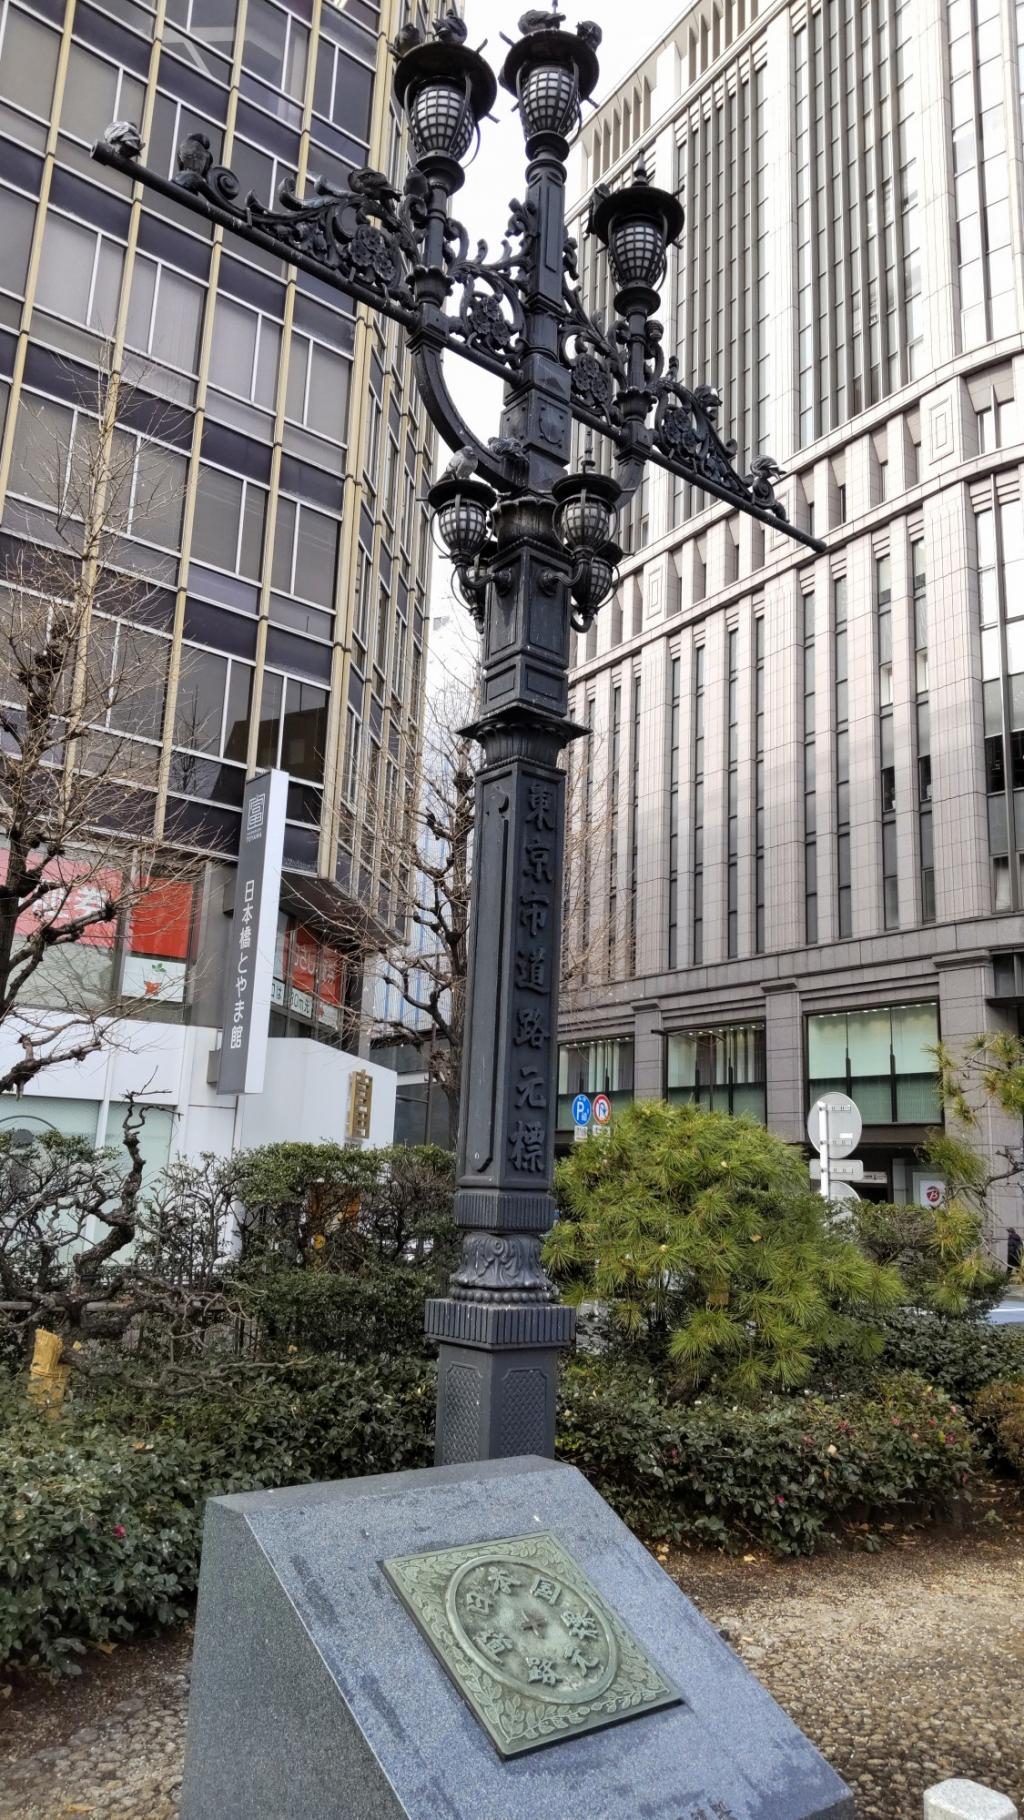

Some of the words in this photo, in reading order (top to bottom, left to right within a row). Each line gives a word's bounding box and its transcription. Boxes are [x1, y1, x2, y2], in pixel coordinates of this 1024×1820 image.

[230, 879, 255, 1049] 日本橋とやま館
[510, 784, 554, 1172] 東京市道路元標
